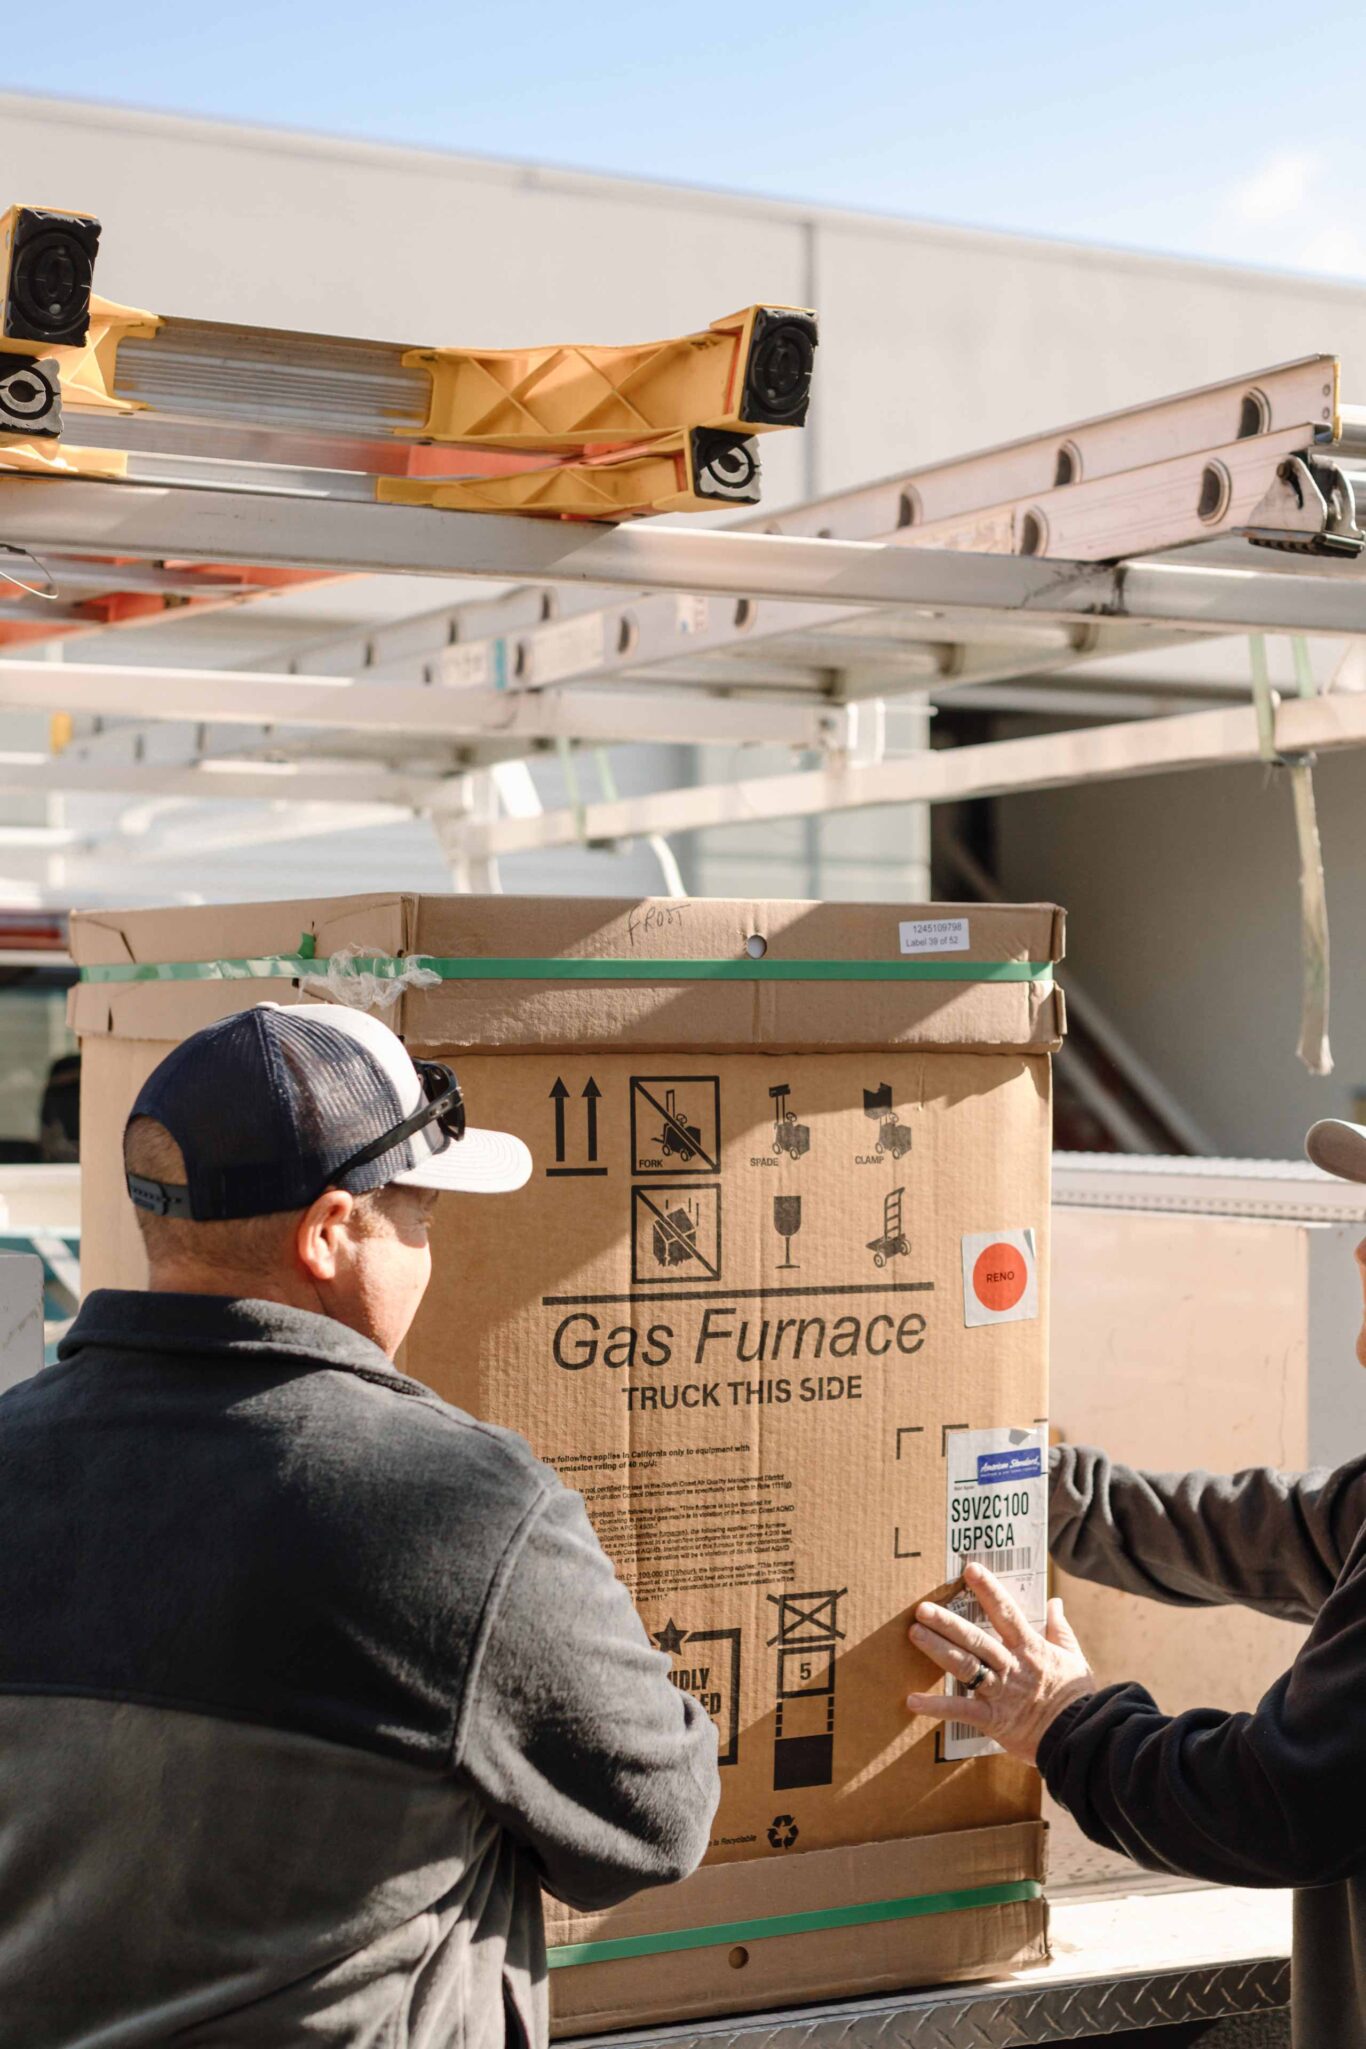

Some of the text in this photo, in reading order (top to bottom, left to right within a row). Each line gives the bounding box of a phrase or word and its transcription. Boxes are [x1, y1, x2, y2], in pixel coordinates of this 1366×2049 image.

[906, 936, 926, 947] Label
[940, 936, 947, 945] of
[638, 1158, 664, 1168] FORK
[750, 1157, 779, 1168] SPADE
[854, 1154, 884, 1166] CLAMP
[986, 1271, 1014, 1284] RENO
[552, 1307, 927, 1371] Gas Furnace
[622, 1376, 862, 1411] TRUCK THIS SIDE
[558, 1454, 592, 1463] following
[593, 1452, 620, 1461] applies
[631, 1449, 667, 1458] California
[669, 1448, 684, 1456] only
[695, 1445, 733, 1455] equipment
[560, 1464, 593, 1472] emission
[596, 1462, 617, 1471] rating
[980, 1462, 1008, 1472] American
[952, 1492, 1028, 1522] S9V2C100
[952, 1523, 1014, 1552] U5PSCA
[800, 1662, 812, 1680] 5
